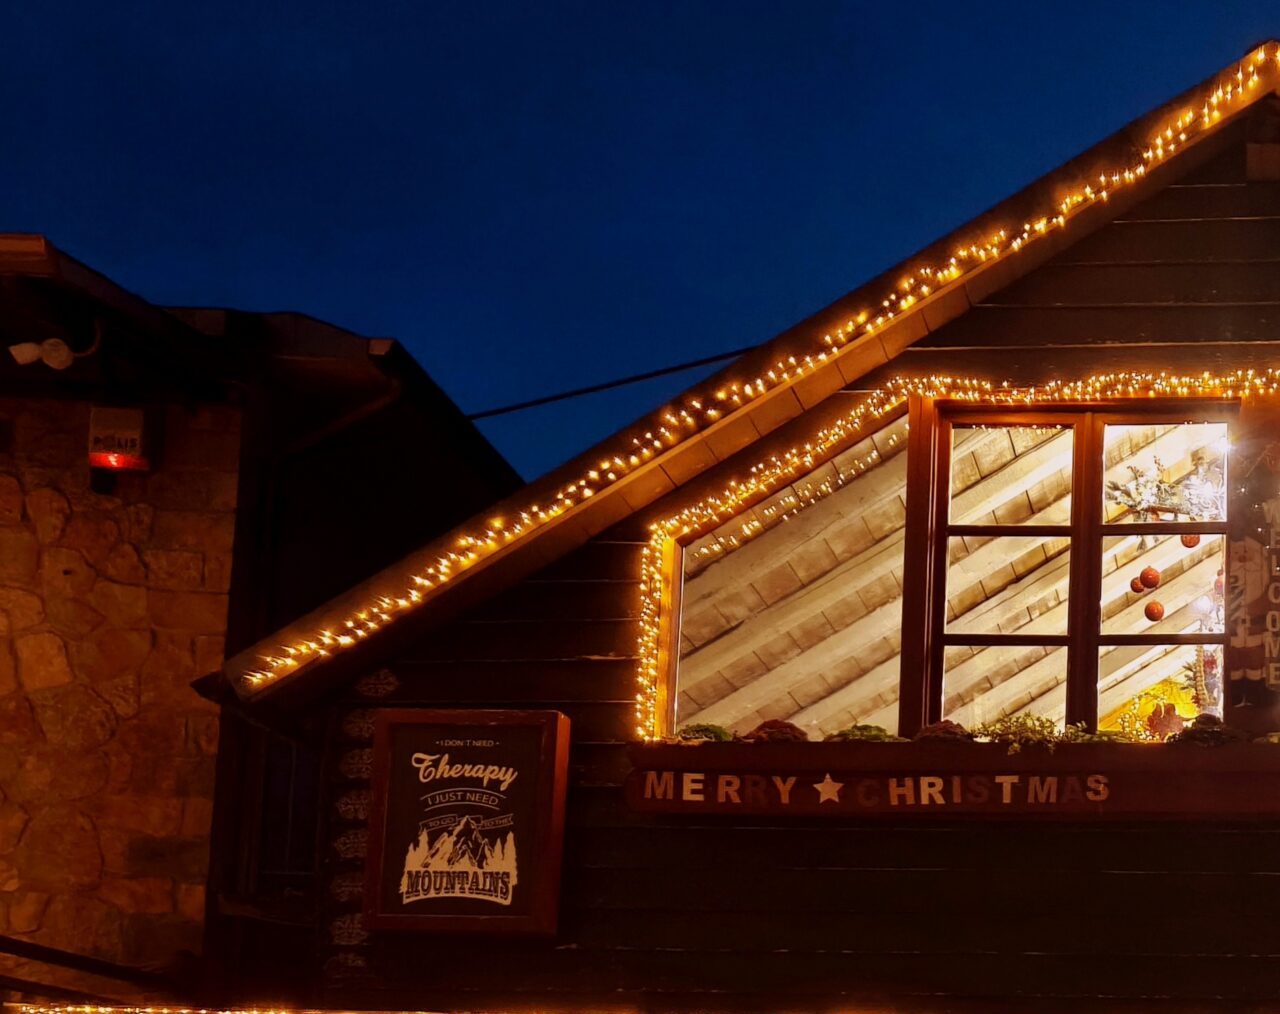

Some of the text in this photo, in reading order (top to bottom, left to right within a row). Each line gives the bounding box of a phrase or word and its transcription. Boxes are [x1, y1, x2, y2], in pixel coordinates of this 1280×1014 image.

[472, 739, 495, 748] NEED
[411, 752, 519, 792] Therapy
[433, 792, 464, 805] JUST
[465, 791, 500, 806] NEED
[643, 770, 1110, 807] MERRY CHRISTMAS
[440, 817, 455, 825] GO
[404, 869, 511, 900] MOUNTAINS
